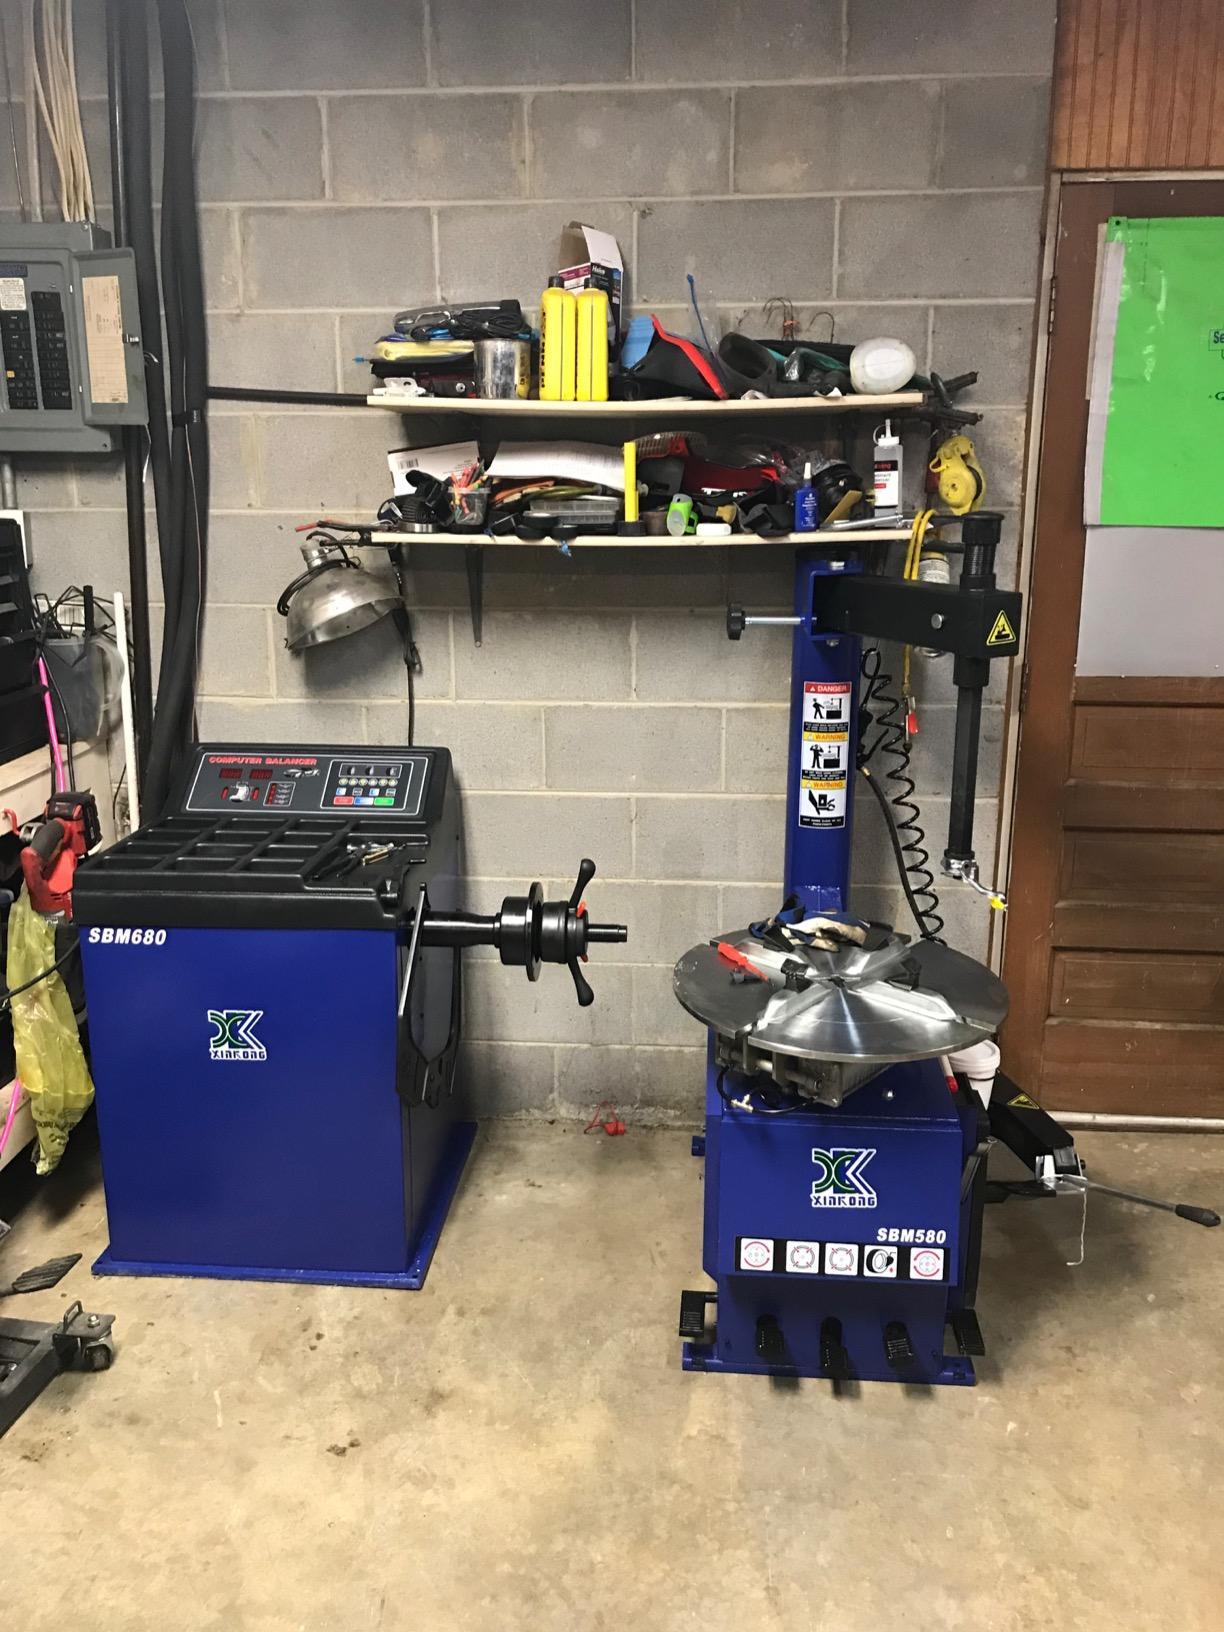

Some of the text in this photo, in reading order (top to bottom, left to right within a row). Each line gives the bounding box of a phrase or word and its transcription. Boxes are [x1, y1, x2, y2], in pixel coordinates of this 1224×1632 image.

[817, 684, 847, 692] DANGER
[208, 756, 318, 766] COMPUTER BALANCER
[88, 927, 167, 946] SBM680
[876, 1227, 947, 1244] SBM580
